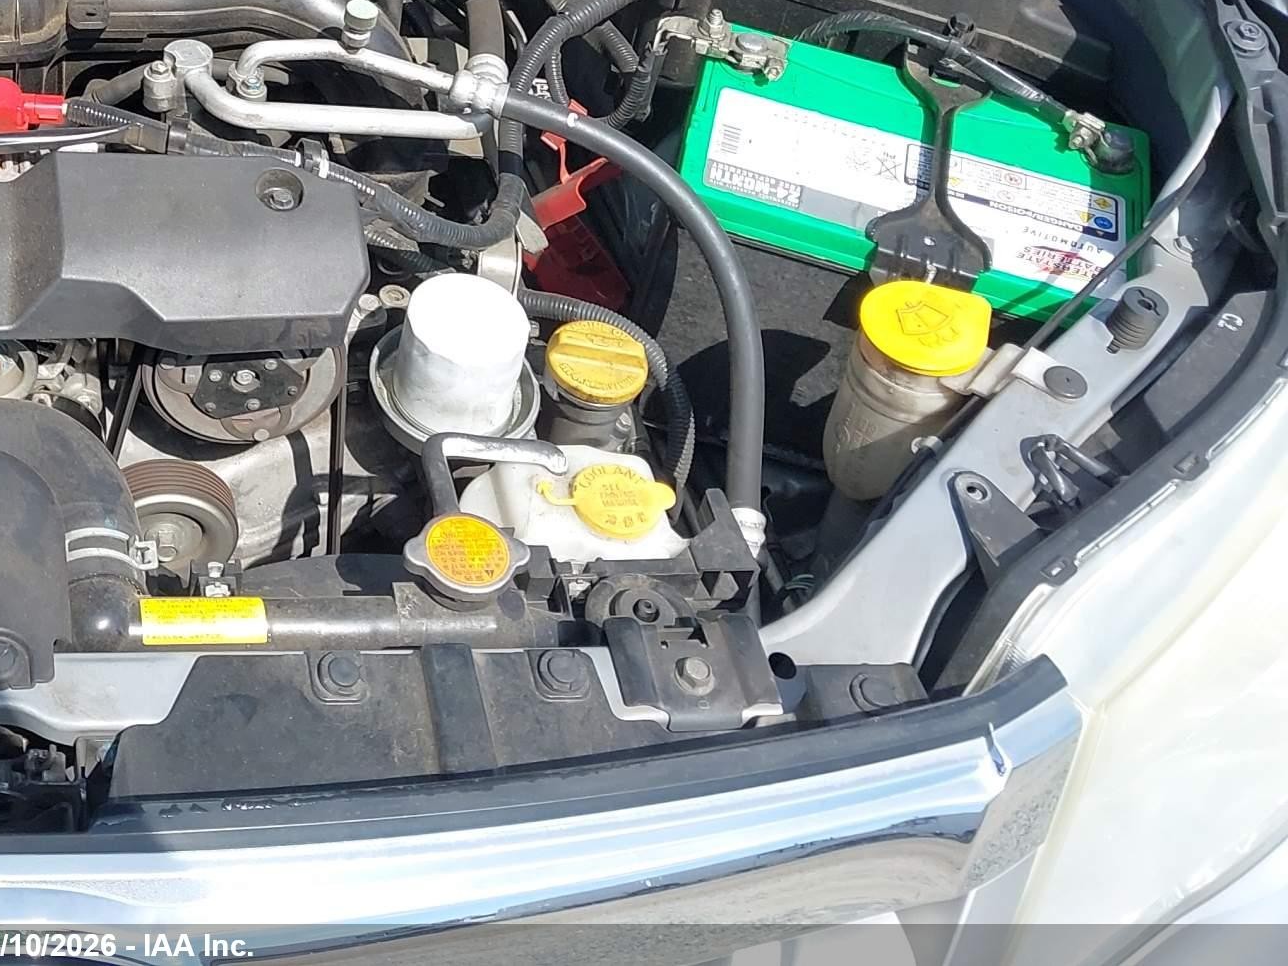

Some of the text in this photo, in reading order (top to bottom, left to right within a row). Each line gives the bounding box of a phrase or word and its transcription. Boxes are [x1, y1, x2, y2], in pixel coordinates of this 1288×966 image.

[711, 167, 801, 204] 24-MONTH
[988, 200, 1083, 232] DANGER/POISON
[1023, 225, 1104, 254] AUTOMOTIVE
[579, 466, 647, 489] COOLANT
